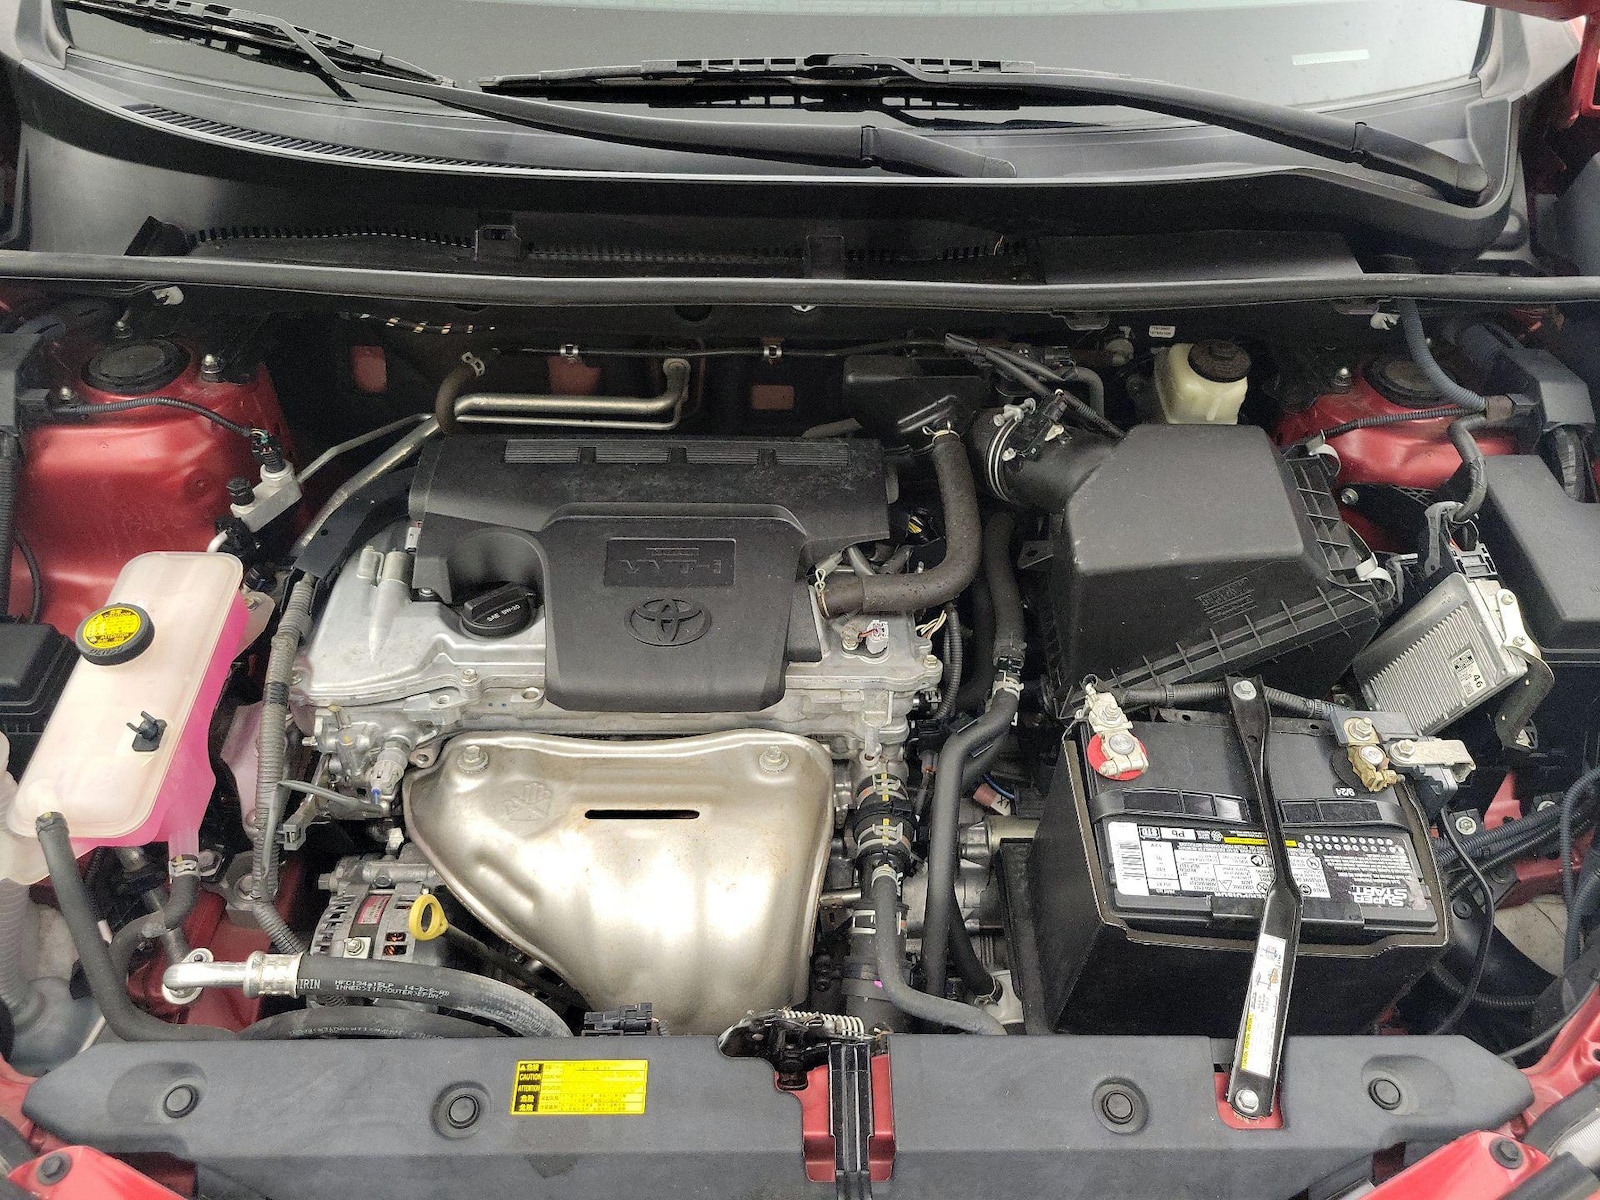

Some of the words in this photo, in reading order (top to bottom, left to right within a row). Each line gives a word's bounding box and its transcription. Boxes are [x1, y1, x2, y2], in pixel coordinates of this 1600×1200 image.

[1335, 787, 1355, 797] 9/24
[1171, 831, 1186, 839] Pb
[1351, 886, 1408, 899] START
[1352, 894, 1405, 907] SUPER
[519, 1073, 542, 1081] CAUTION
